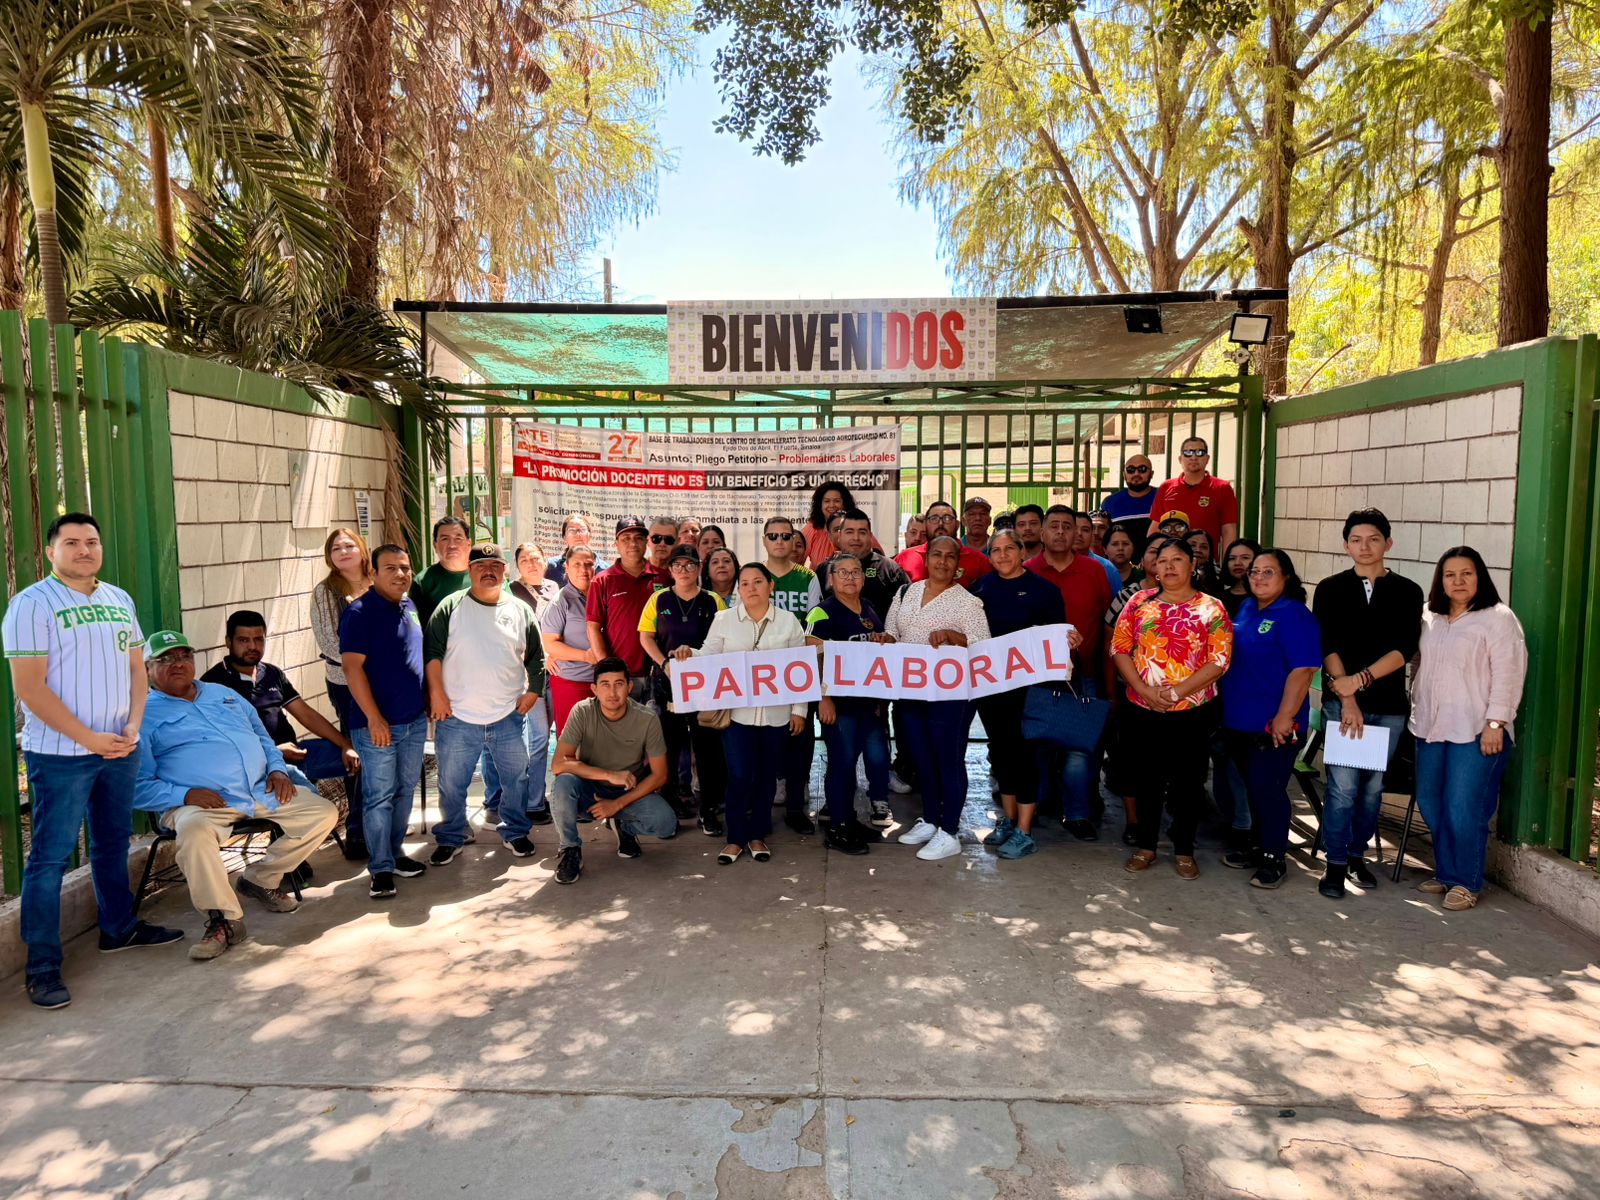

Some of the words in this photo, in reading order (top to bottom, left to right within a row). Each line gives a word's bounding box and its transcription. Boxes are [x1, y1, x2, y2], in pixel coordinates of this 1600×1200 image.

[702, 310, 965, 373] BIENVENIDOS
[608, 434, 639, 455] 27
[649, 435, 663, 444] BASE
[664, 436, 671, 444] DE
[672, 437, 714, 446] TRABAJADORES
[715, 438, 726, 446] DEL
[726, 438, 748, 447] CENTRO
[749, 438, 756, 446] DE
[757, 437, 797, 446] BACHILLERATO
[798, 434, 836, 445] TECNOLÓGICO
[649, 453, 693, 465] Asunto:
[695, 454, 726, 467] Pliego
[728, 454, 768, 465] Petitorio
[779, 452, 846, 465] Problemáticas
[849, 451, 896, 464] Laborales
[542, 464, 608, 483] PROMOCIÓN
[611, 472, 665, 487] DOCENTE
[668, 474, 686, 487] NO
[688, 475, 704, 487] ES
[706, 475, 723, 487] UN
[726, 475, 788, 488] BENEFICIO
[791, 475, 806, 488] ES
[809, 475, 826, 487] UN
[538, 505, 591, 518] solicitamos
[693, 516, 740, 525] nmediata
[742, 517, 749, 525] a
[750, 515, 764, 525] las
[55, 604, 132, 630] TIGRES
[679, 659, 815, 703] PARO
[832, 638, 1067, 689] LABORAL
